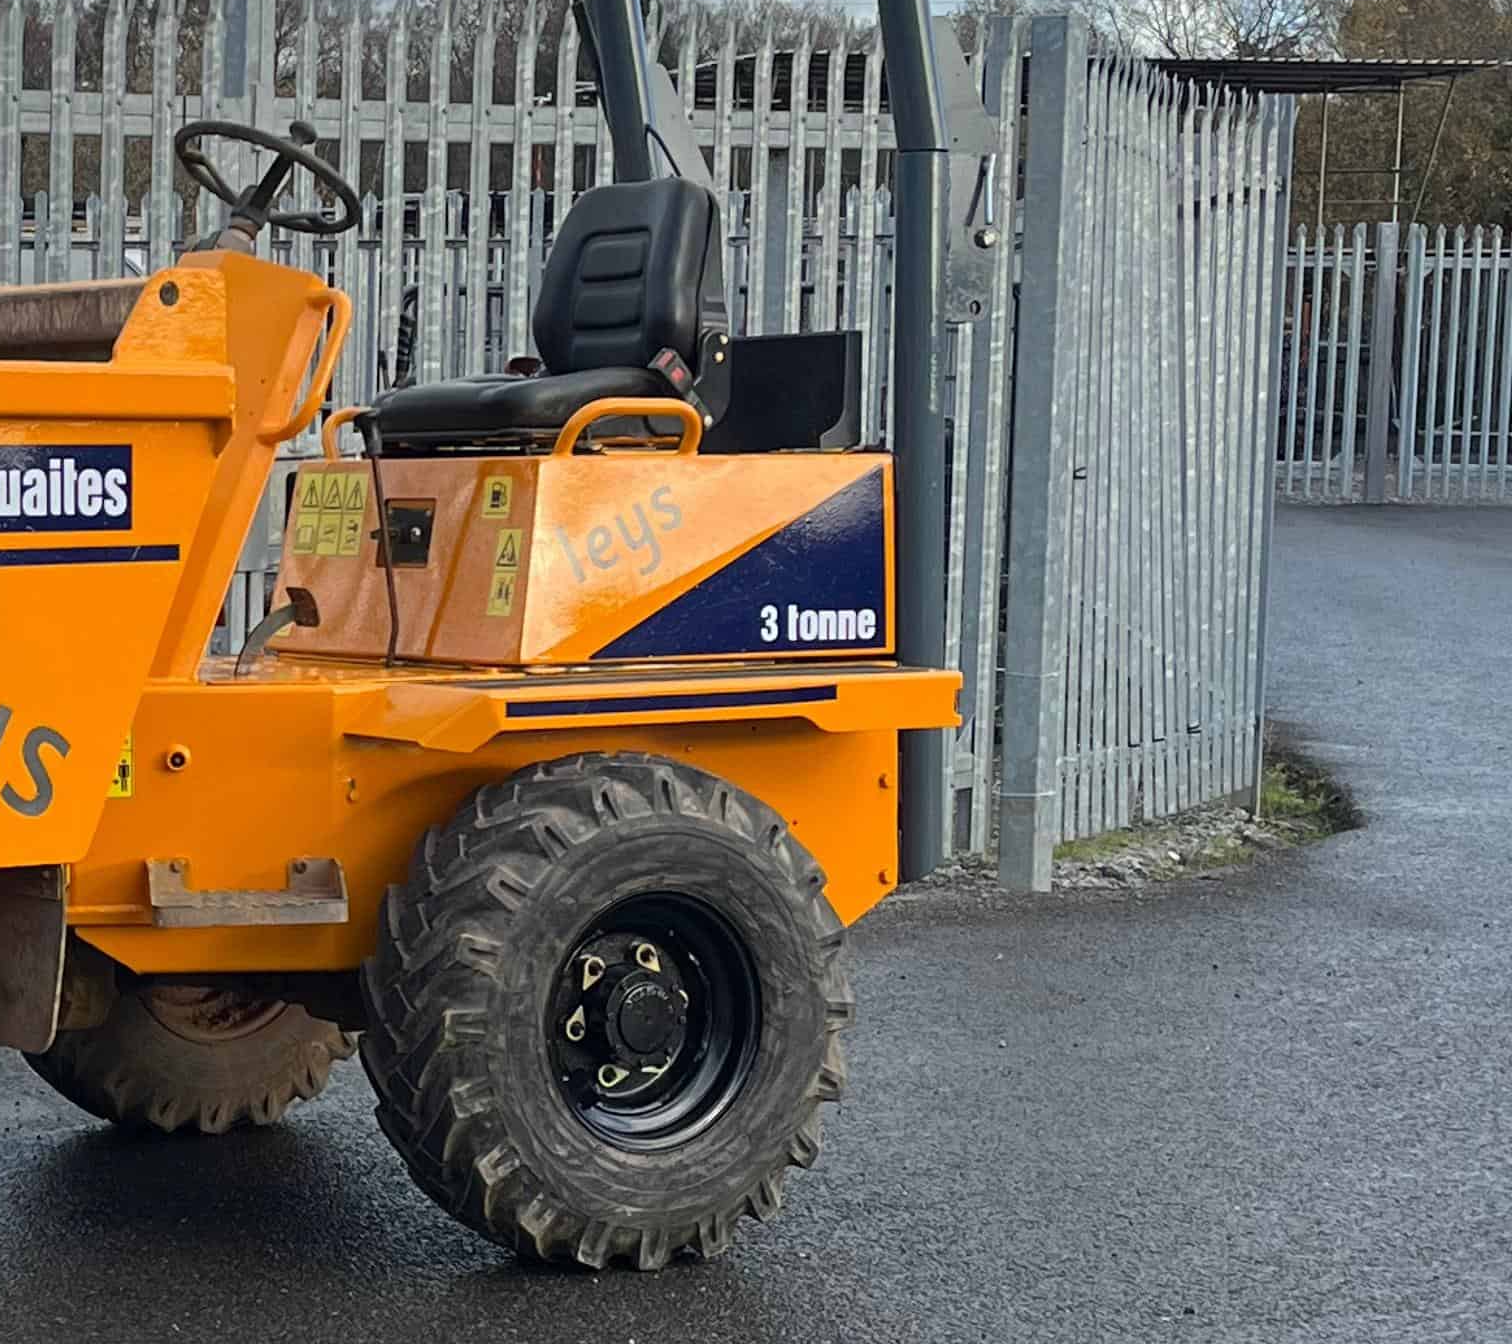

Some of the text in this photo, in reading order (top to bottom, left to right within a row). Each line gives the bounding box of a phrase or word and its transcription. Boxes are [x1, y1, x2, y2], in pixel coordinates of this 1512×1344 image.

[555, 485, 683, 584] leys
[760, 603, 877, 643] 3 tonne
